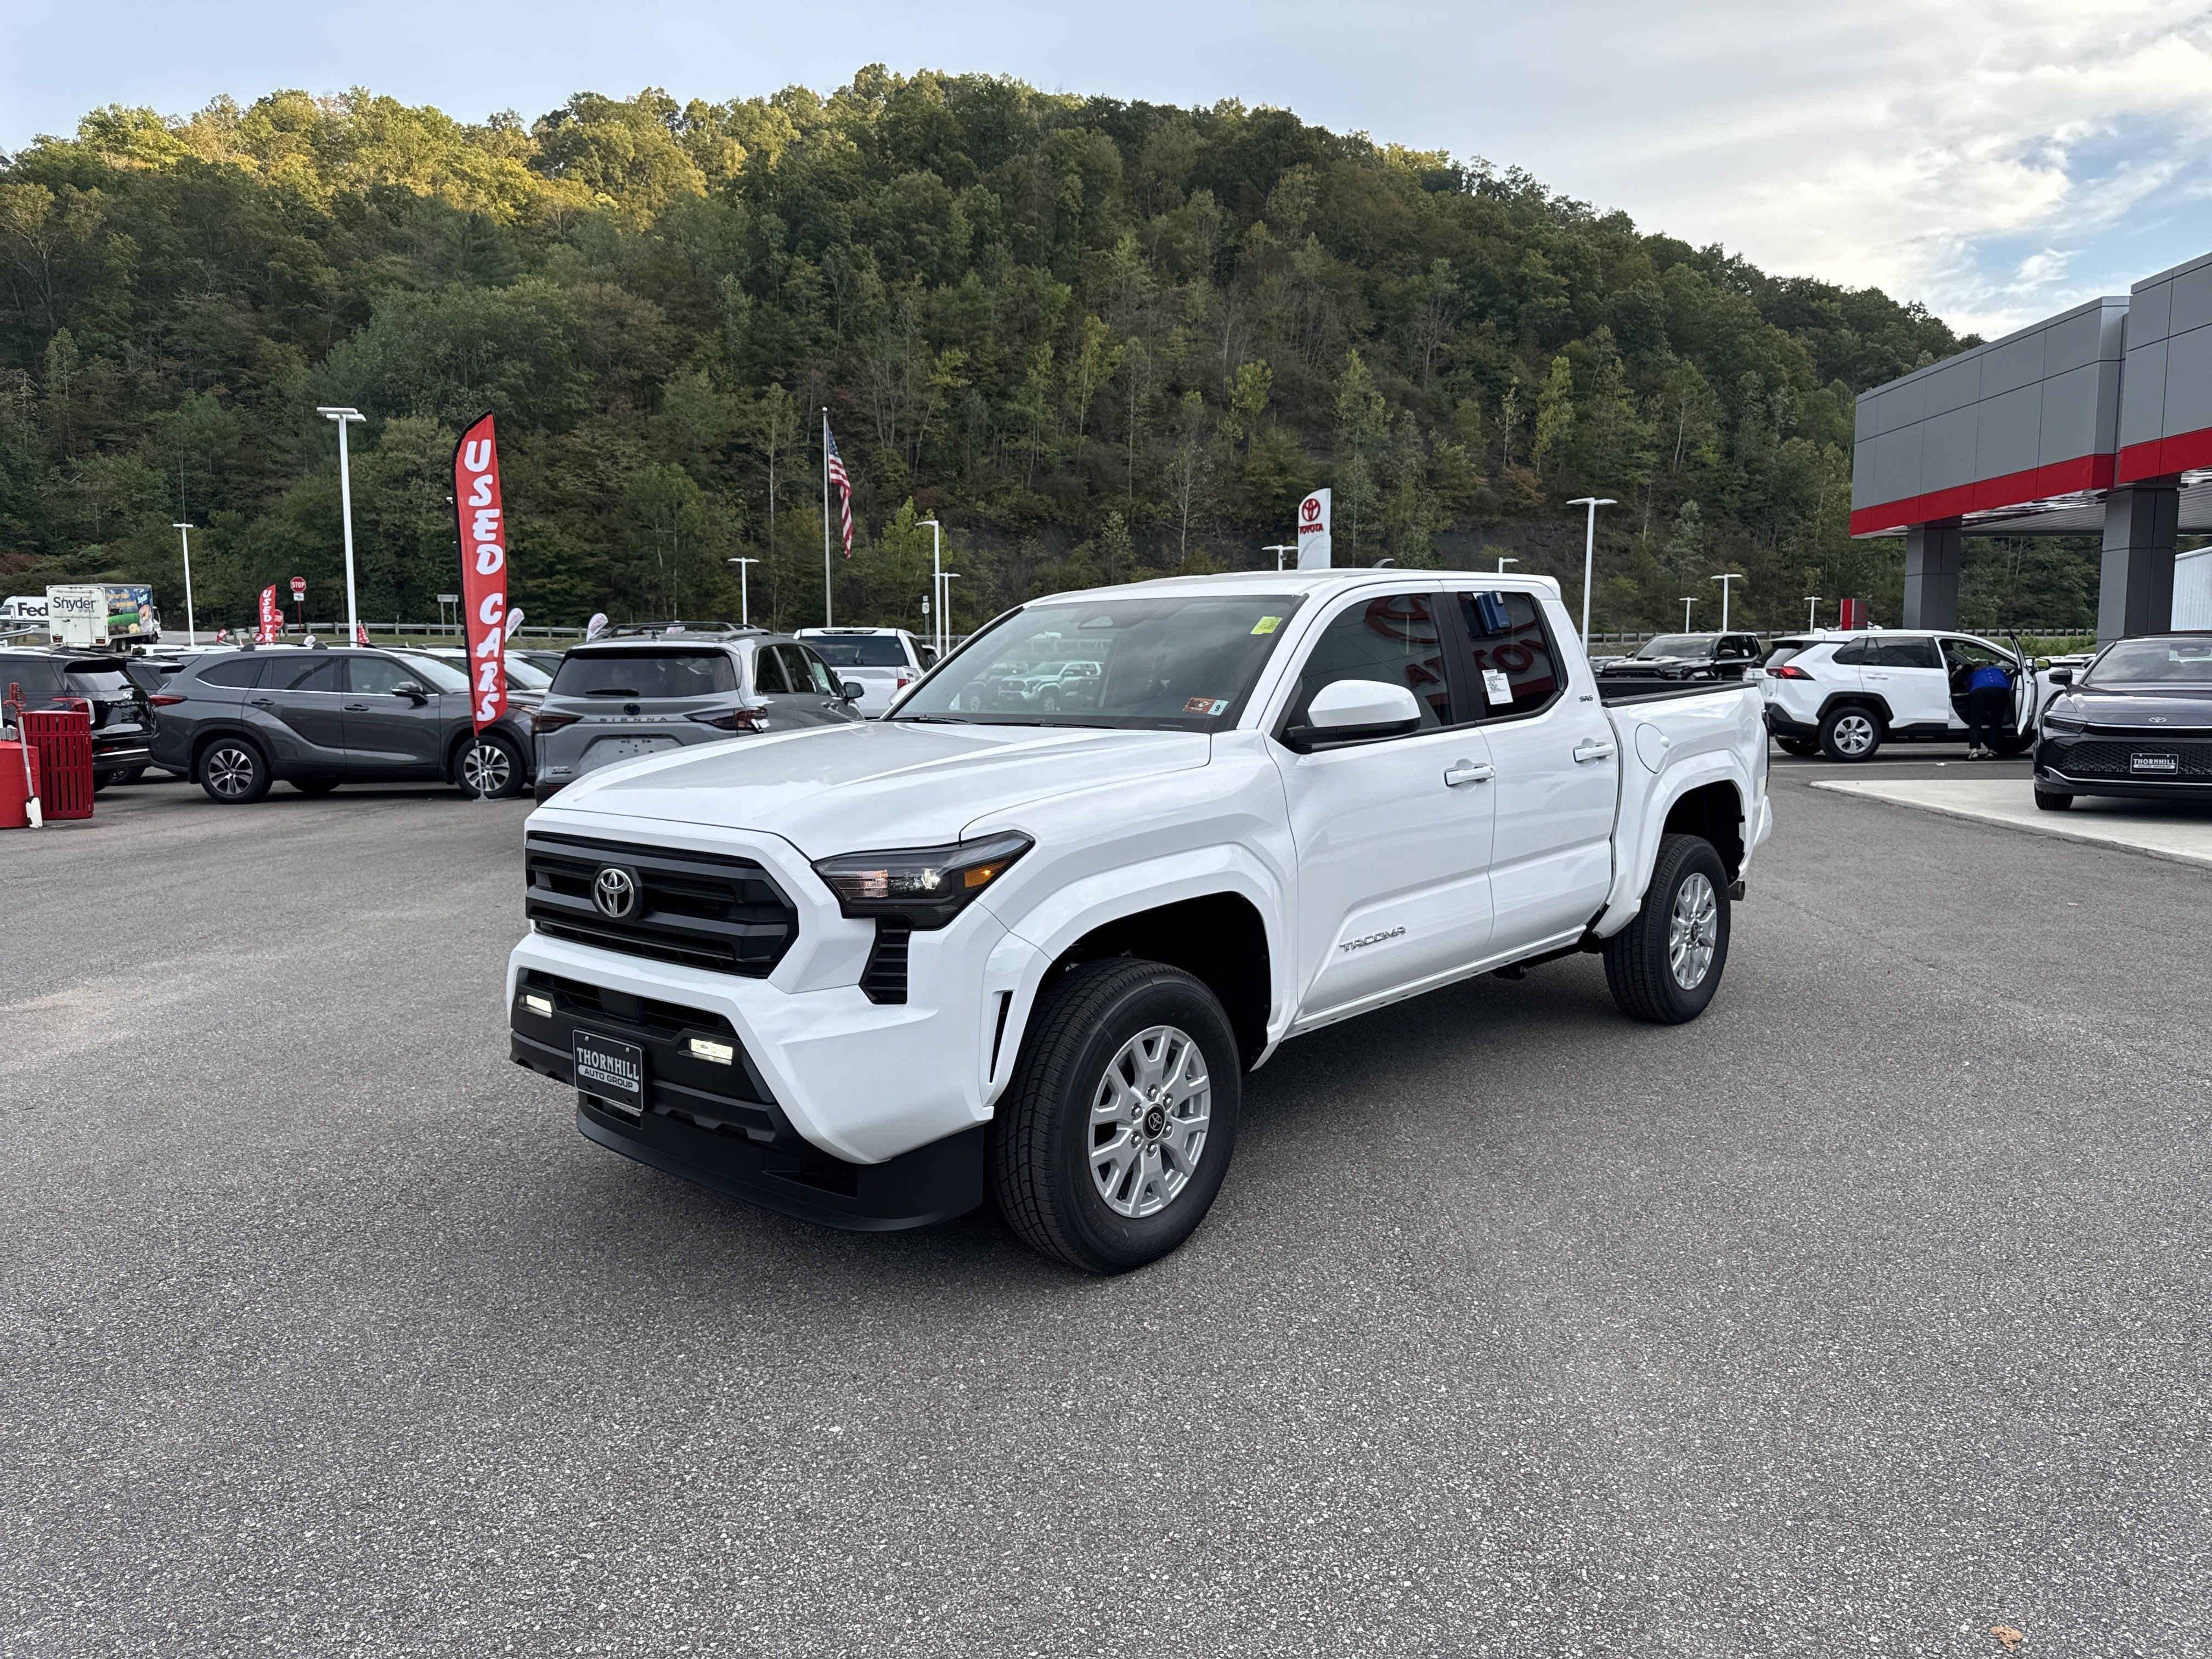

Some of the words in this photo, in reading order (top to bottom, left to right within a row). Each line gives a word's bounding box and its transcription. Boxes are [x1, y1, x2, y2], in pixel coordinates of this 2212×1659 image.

[464, 439, 504, 575] USED
[1299, 523, 1324, 535] TOYOTA
[53, 596, 97, 612] Snyder
[262, 589, 272, 623] USED
[264, 624, 274, 646] TR
[476, 592, 503, 722] CARS
[1339, 926, 1406, 952] TACOMA
[577, 1047, 640, 1081] THORNHILL
[584, 1068, 605, 1080] AUTO
[607, 1075, 633, 1089] GROUP
